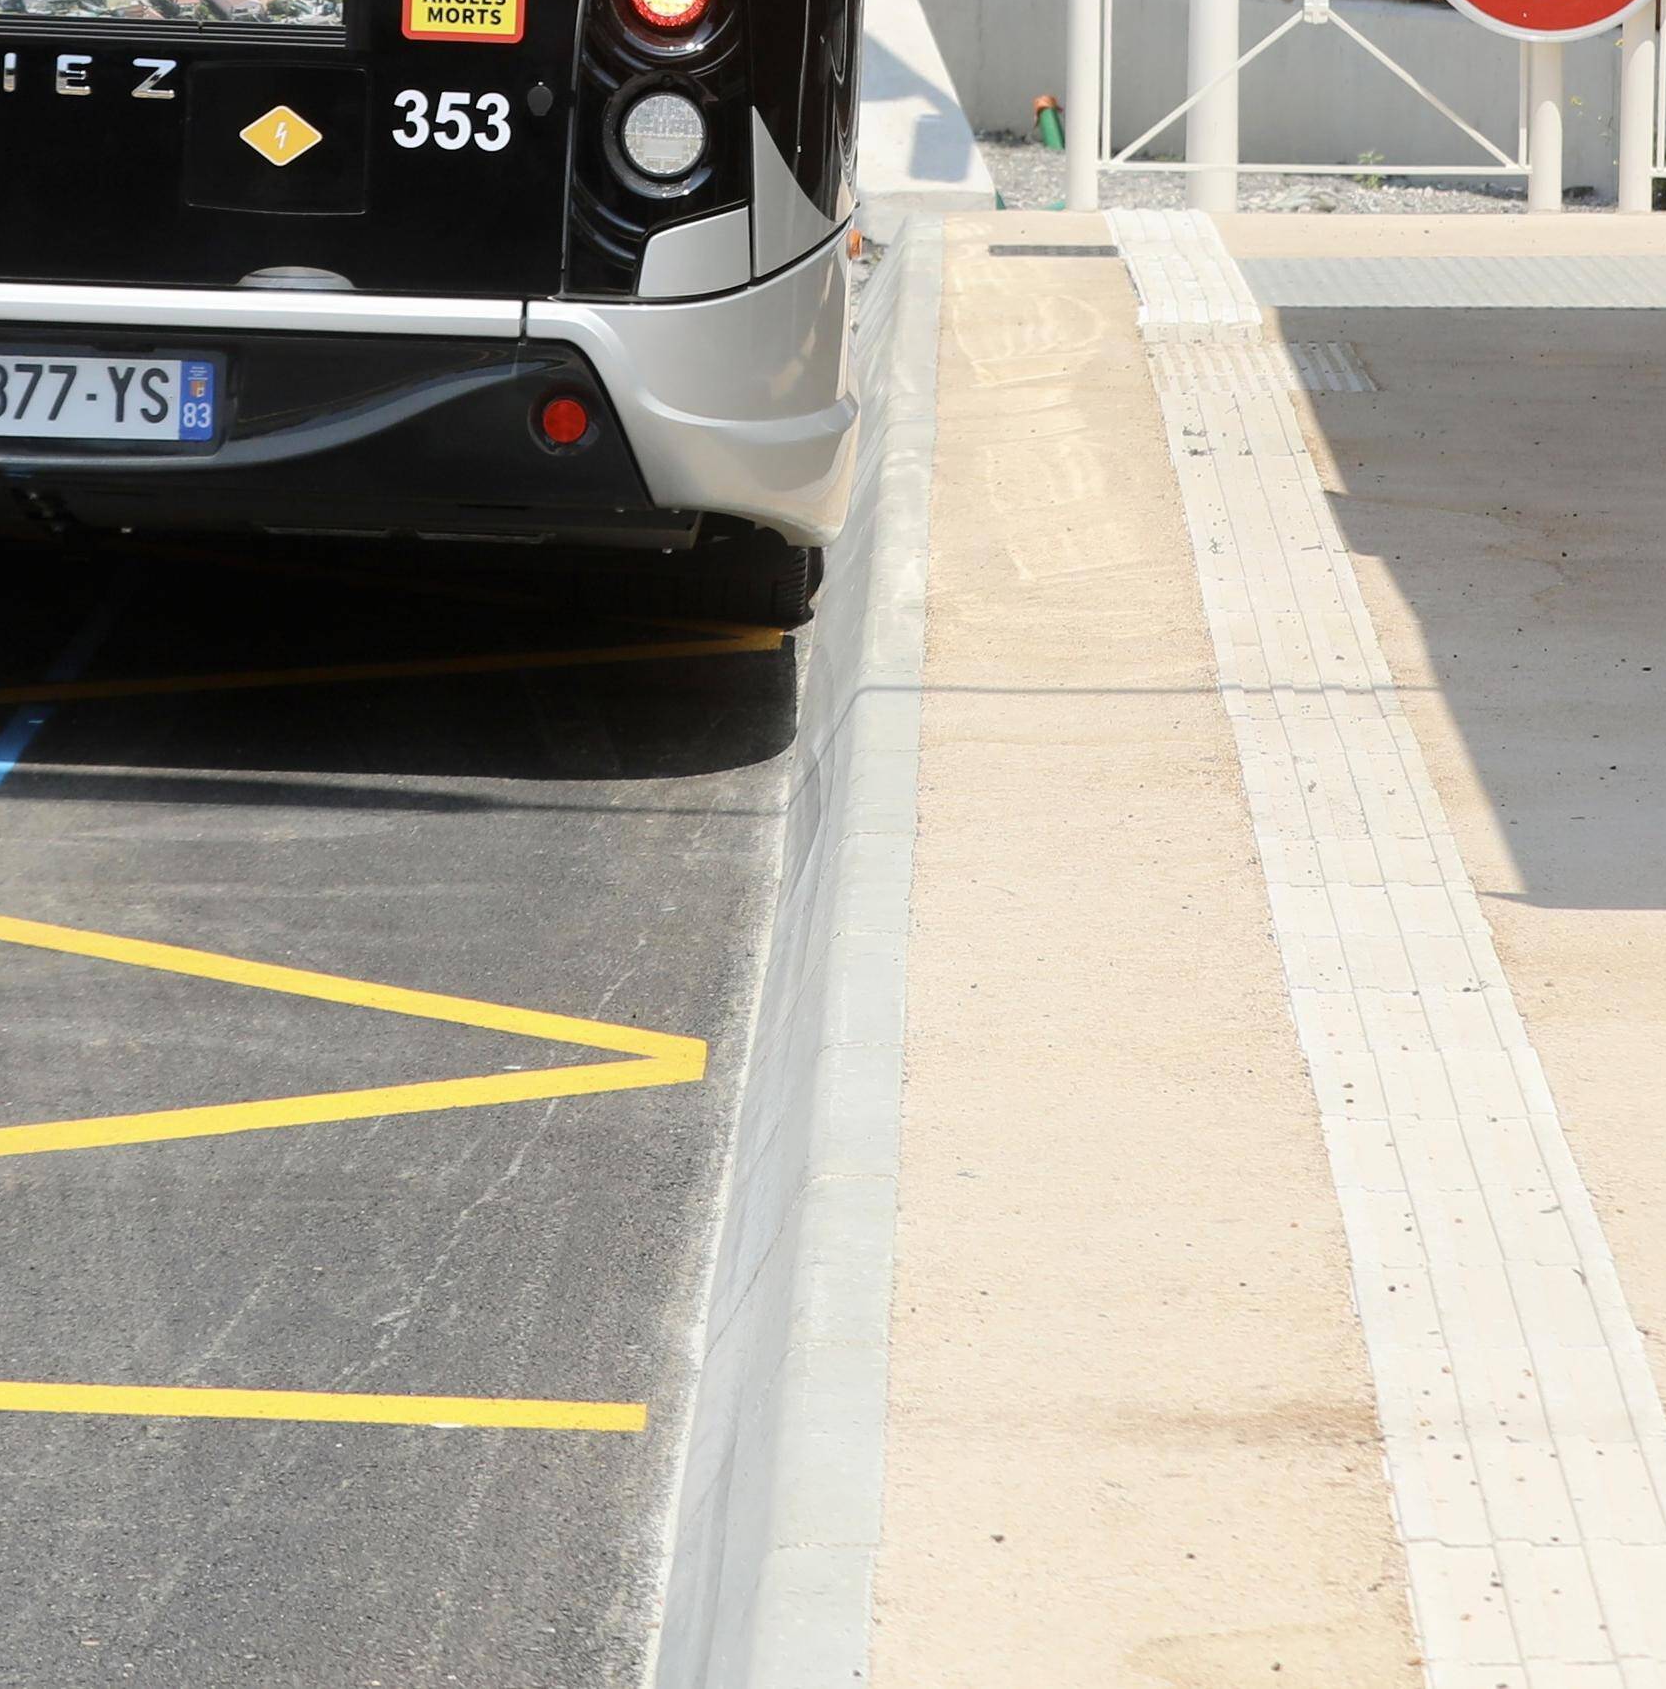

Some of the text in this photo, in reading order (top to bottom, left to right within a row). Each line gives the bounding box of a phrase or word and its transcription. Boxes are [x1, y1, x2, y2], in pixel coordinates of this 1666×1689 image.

[427, 7, 502, 25] MORTS
[392, 89, 512, 152] 353
[183, 402, 212, 428] 83
